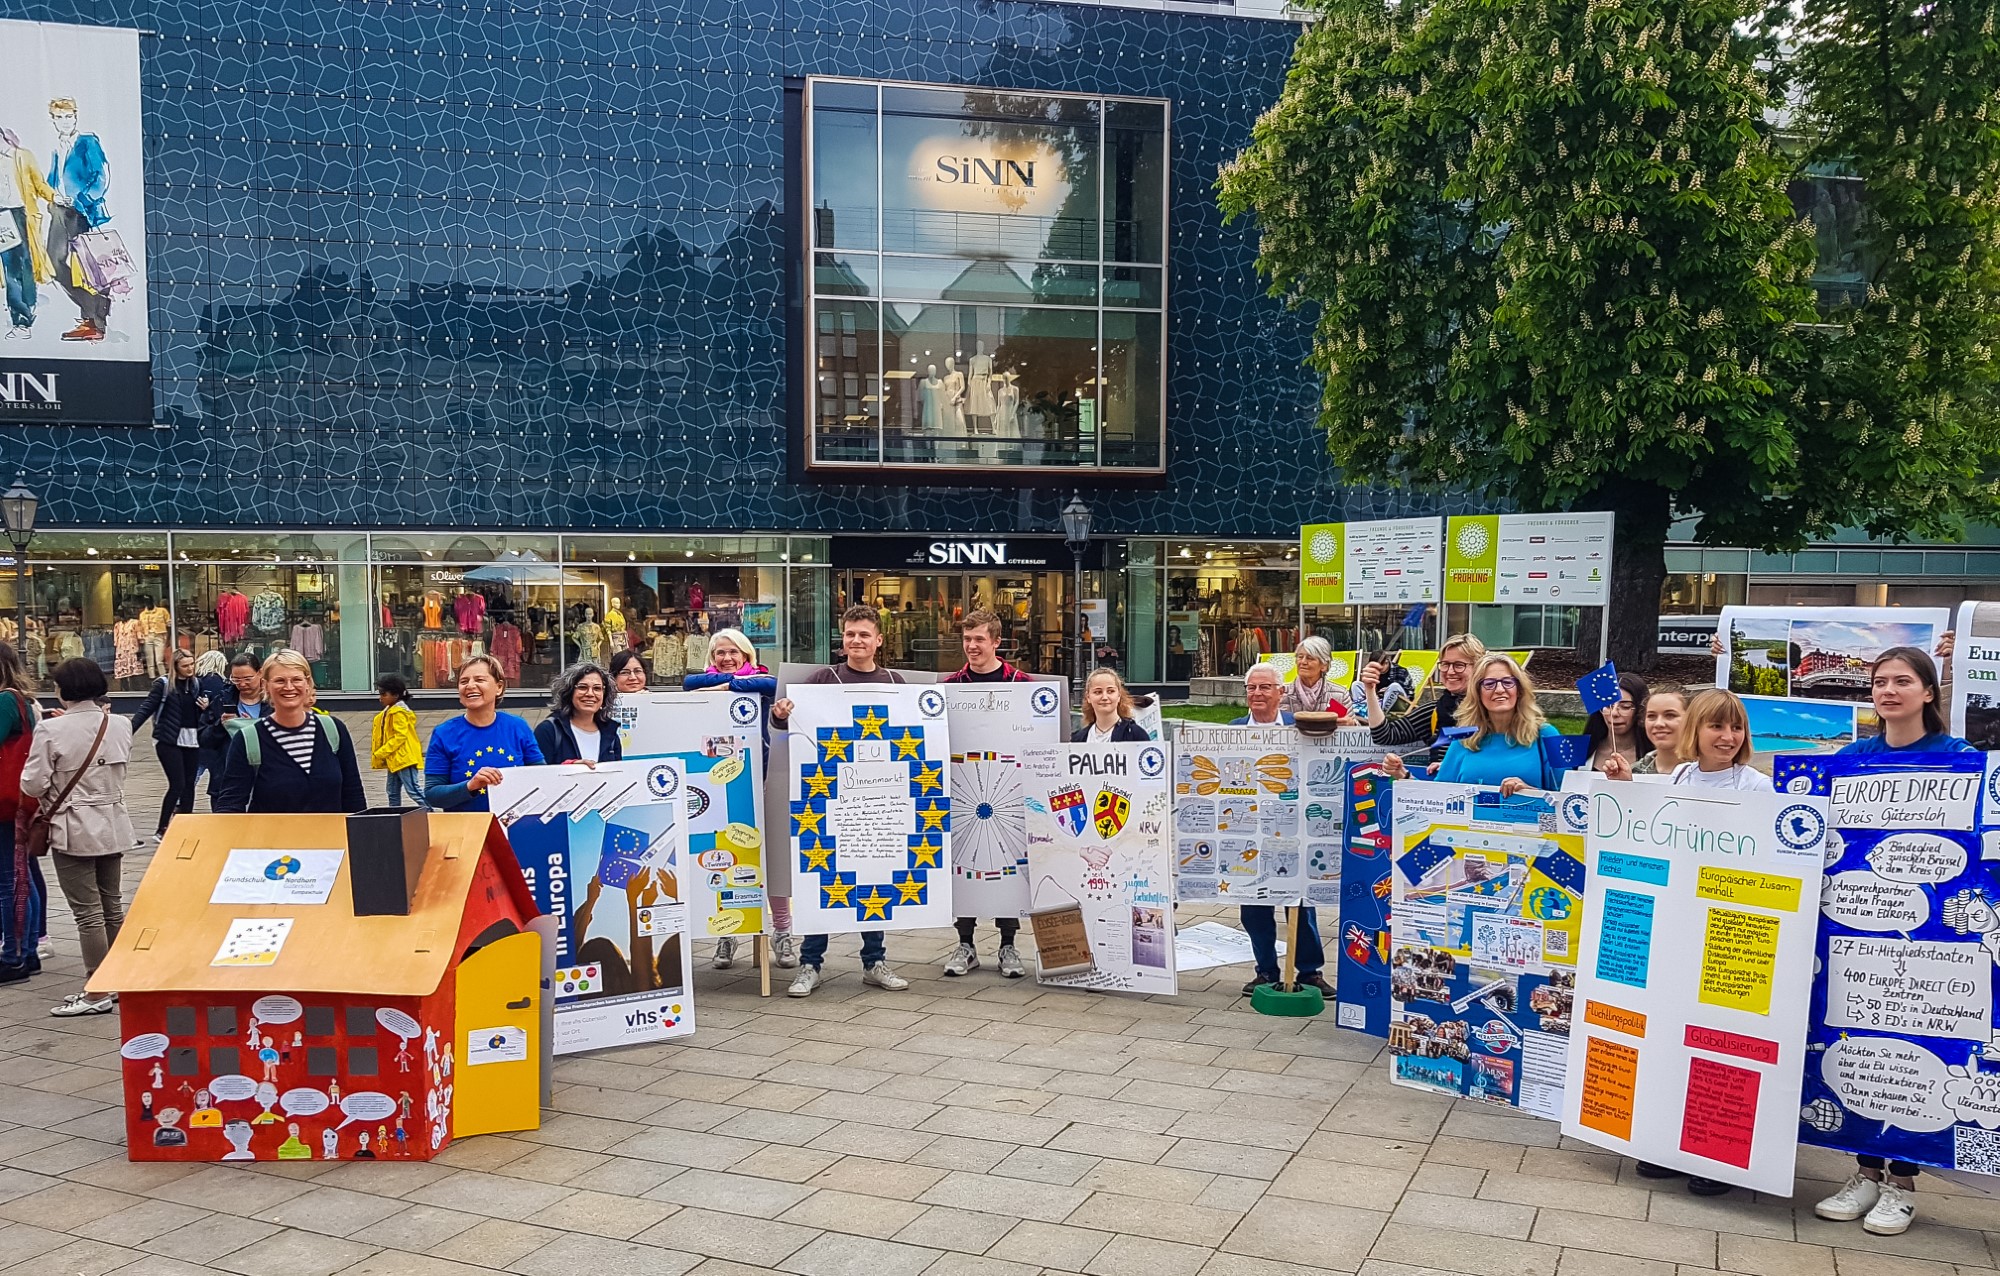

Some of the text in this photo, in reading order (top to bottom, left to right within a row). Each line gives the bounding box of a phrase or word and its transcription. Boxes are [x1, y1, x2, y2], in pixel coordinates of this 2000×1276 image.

[936, 155, 1037, 188] SiNN
[928, 542, 1007, 564] SiNN
[430, 570, 466, 581] s.Oliver
[1658, 631, 1711, 645] nterp
[1968, 669, 1997, 681] am
[978, 697, 986, 710] &
[1012, 723, 1035, 732] Urlaub
[1179, 728, 1300, 745] GELD REGIERT die WELT?
[1313, 731, 1373, 747] GEMEINSAM
[857, 744, 881, 761] EU
[1182, 744, 1225, 754] Wirtschaft
[1068, 753, 1127, 776] PALAH
[842, 766, 905, 789] Binnenmarkt
[1047, 782, 1081, 798] Les Andelys
[1793, 780, 1808, 792] EU
[1831, 779, 1902, 805] EUROPE
[1904, 777, 1980, 803] DIRECT
[1397, 797, 1444, 807] Reinhard Mohn
[1405, 804, 1444, 815] Berufskolleg
[1501, 800, 1549, 813] Erasmus+
[1593, 792, 1756, 857] Die Grünen
[1836, 806, 1946, 828] Kreis Gütersloh
[1139, 821, 1162, 835] NRW
[1826, 850, 1838, 860] EU
[1888, 840, 1942, 856] Bindeglied
[1600, 852, 1624, 865] Frieden
[1625, 858, 1638, 867] und
[1887, 853, 1962, 868] zwischen Brüssel
[1600, 863, 1622, 875] rechte
[1876, 863, 1950, 881] + dem Kreis GT
[1087, 878, 1111, 891] 1994
[1700, 867, 1796, 895] Europäischer Zusam-
[1832, 879, 1915, 897] Ansprechpartner
[1697, 883, 1736, 899] menhalt
[1835, 894, 1905, 911] bei allen Fragen
[1835, 905, 1918, 923] rund um EUROPA
[1746, 928, 1770, 939] möglich
[1735, 938, 1753, 946] Union
[1707, 950, 1737, 961] Diskussion
[1732, 946, 1742, 954] der
[1741, 947, 1776, 959] öffentlichen
[1831, 938, 1855, 957] 27
[1857, 942, 1974, 965] EU-Mitgliedsstaaten
[1707, 957, 1727, 966] Europa
[1716, 981, 1753, 991] europäischen
[1843, 966, 1976, 998] 400 EUROPE DIRECT (ED)
[1703, 985, 1750, 1000] Entscheidungen
[1881, 987, 1925, 1001] Zentren
[1586, 1001, 1645, 1030] Flüchtlingspolitik
[1866, 998, 1985, 1021] 50 ED's in Deutschland
[582, 1015, 608, 1024] Gütersloh
[625, 1009, 657, 1027] vhs
[1870, 1012, 1958, 1033] 8 ED's in NRW
[625, 1024, 659, 1035] Gütersloh
[1690, 1028, 1770, 1060] Globalisierung
[1836, 1043, 1921, 1063] Möchten Sie mehr
[1485, 1067, 1509, 1080] MUSIC
[1838, 1057, 1919, 1076] über die EU wissen
[1839, 1071, 1936, 1095] und mitdiskutieren?
[1840, 1082, 1927, 1105] Dann schauen Sie
[1846, 1097, 1921, 1117] mal hier vorbei
